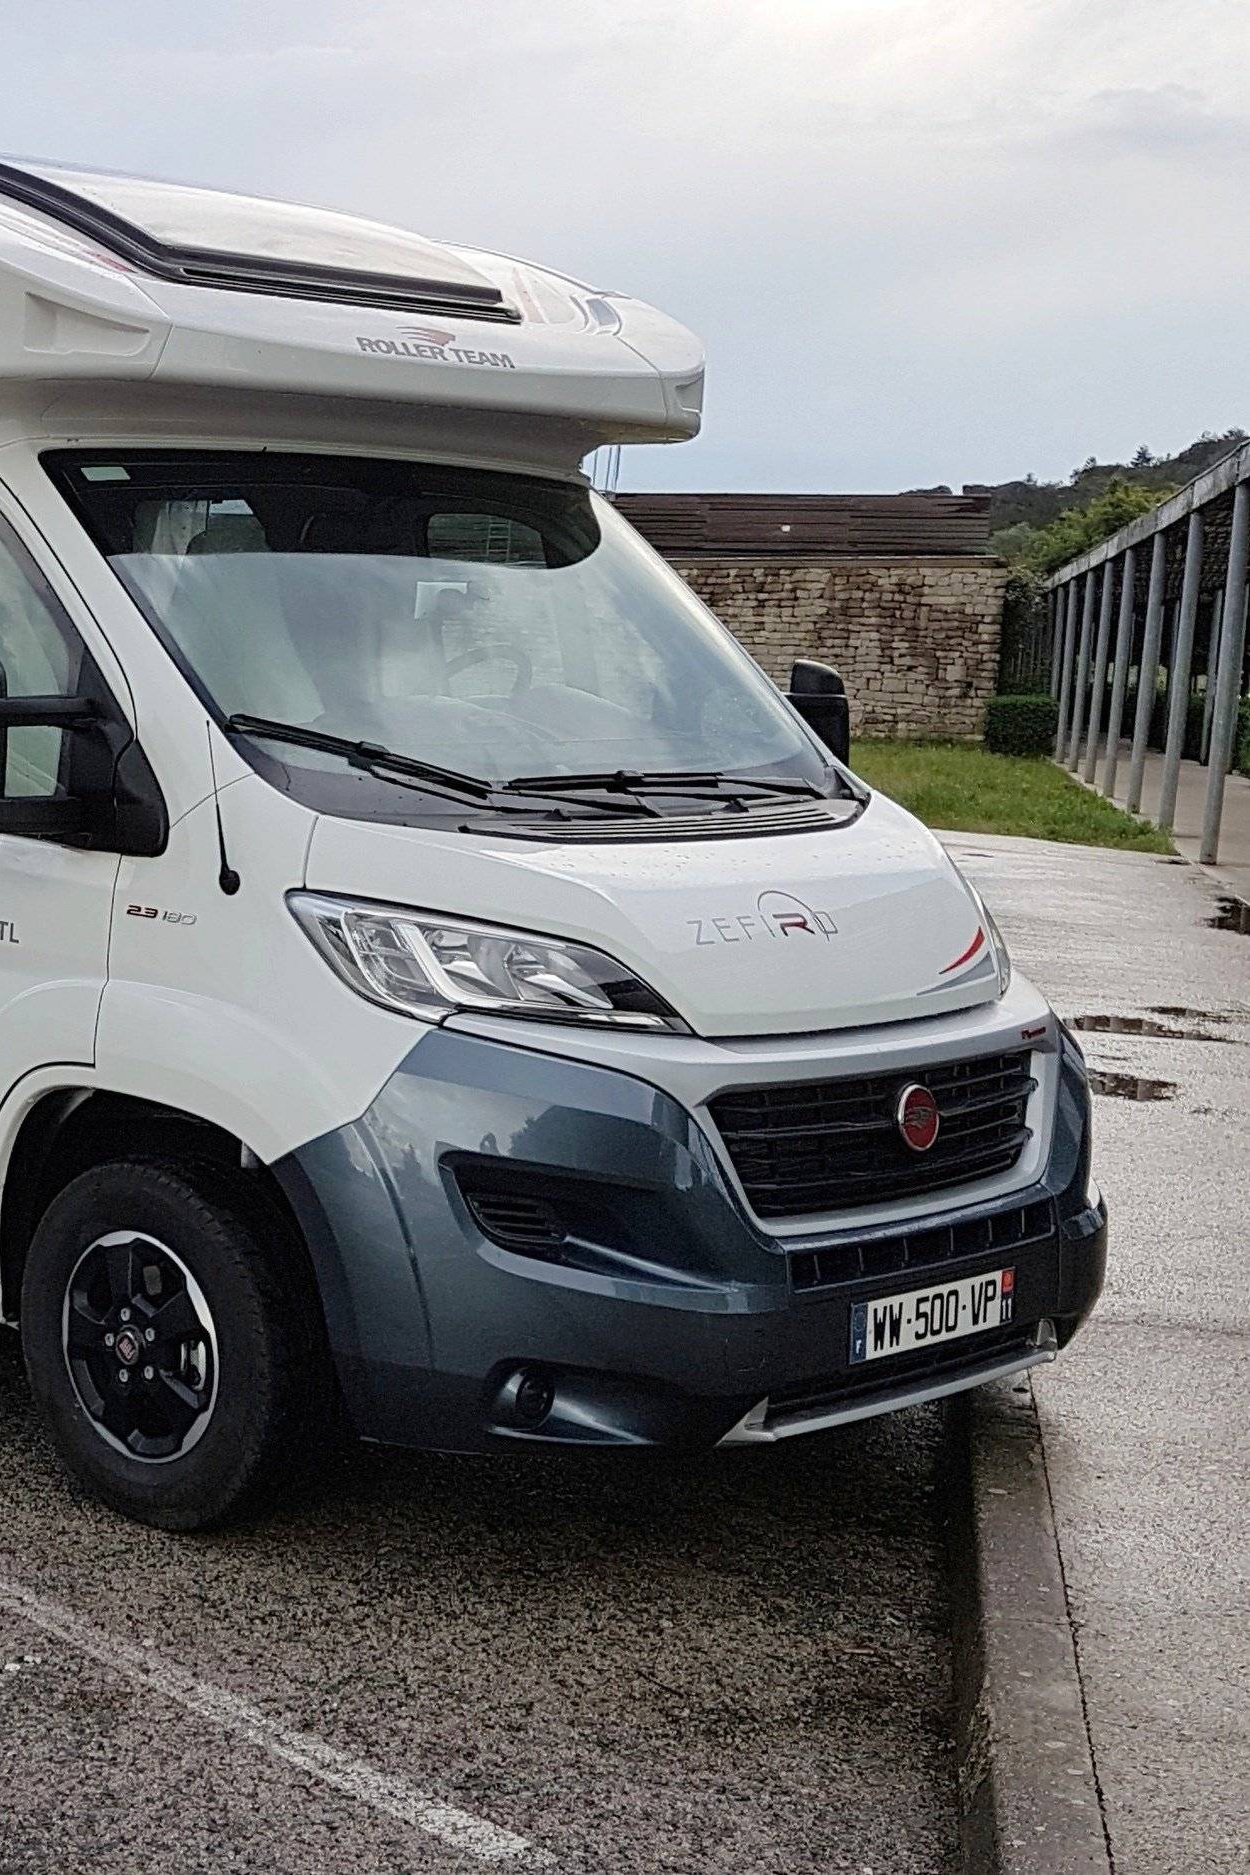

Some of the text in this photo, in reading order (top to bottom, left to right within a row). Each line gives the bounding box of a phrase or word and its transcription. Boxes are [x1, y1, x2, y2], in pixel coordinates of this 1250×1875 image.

[356, 337, 515, 369] ROLLER TEAM
[686, 909, 839, 946] ZEFIRO
